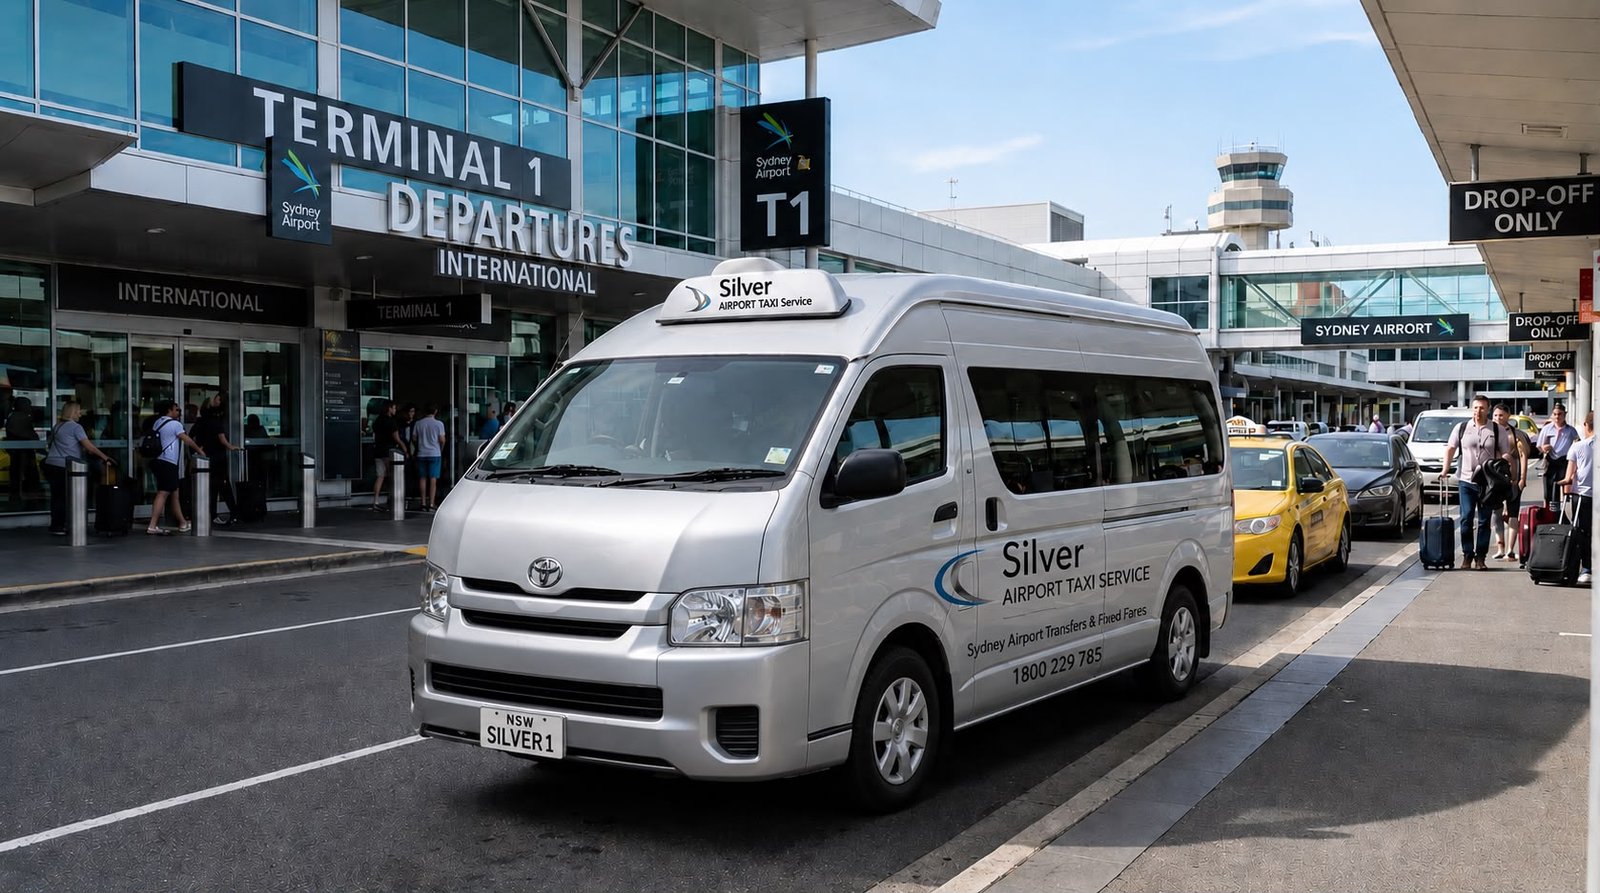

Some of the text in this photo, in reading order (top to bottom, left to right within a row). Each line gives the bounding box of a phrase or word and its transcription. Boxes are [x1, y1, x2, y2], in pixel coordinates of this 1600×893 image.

[253, 87, 541, 196] TERMINAL 1
[755, 167, 791, 179] Airport
[756, 156, 792, 169] Sydney
[1464, 183, 1594, 210] DROP-OFF
[282, 201, 320, 221] Sydney
[756, 190, 809, 237] T1
[282, 215, 320, 231] Airport
[388, 182, 633, 268] DEPARTURES
[1494, 211, 1563, 233] ONLY
[440, 250, 596, 295] INTERNATIONAL
[118, 282, 264, 312] INTERNATIONAL
[719, 277, 772, 298] Silver
[377, 302, 452, 319] TERMINAL 1
[719, 297, 812, 310] AIRPORT TAXI Service
[1315, 324, 1370, 337] SYDNEY
[1515, 315, 1579, 327] DROP-OFF
[1531, 327, 1564, 338] ONLY
[1528, 353, 1571, 361] DROP-OFF
[1003, 539, 1084, 578] Silver
[1002, 566, 1150, 606] AIRPORT TAXI SERVICE
[967, 639, 1005, 659] Sydney
[1007, 631, 1043, 648] Airport
[1045, 620, 1087, 639] Transfers
[1089, 615, 1096, 628] &
[1123, 606, 1147, 620] Fares
[1013, 647, 1102, 685] 1800 229 785
[506, 713, 533, 728] NSW
